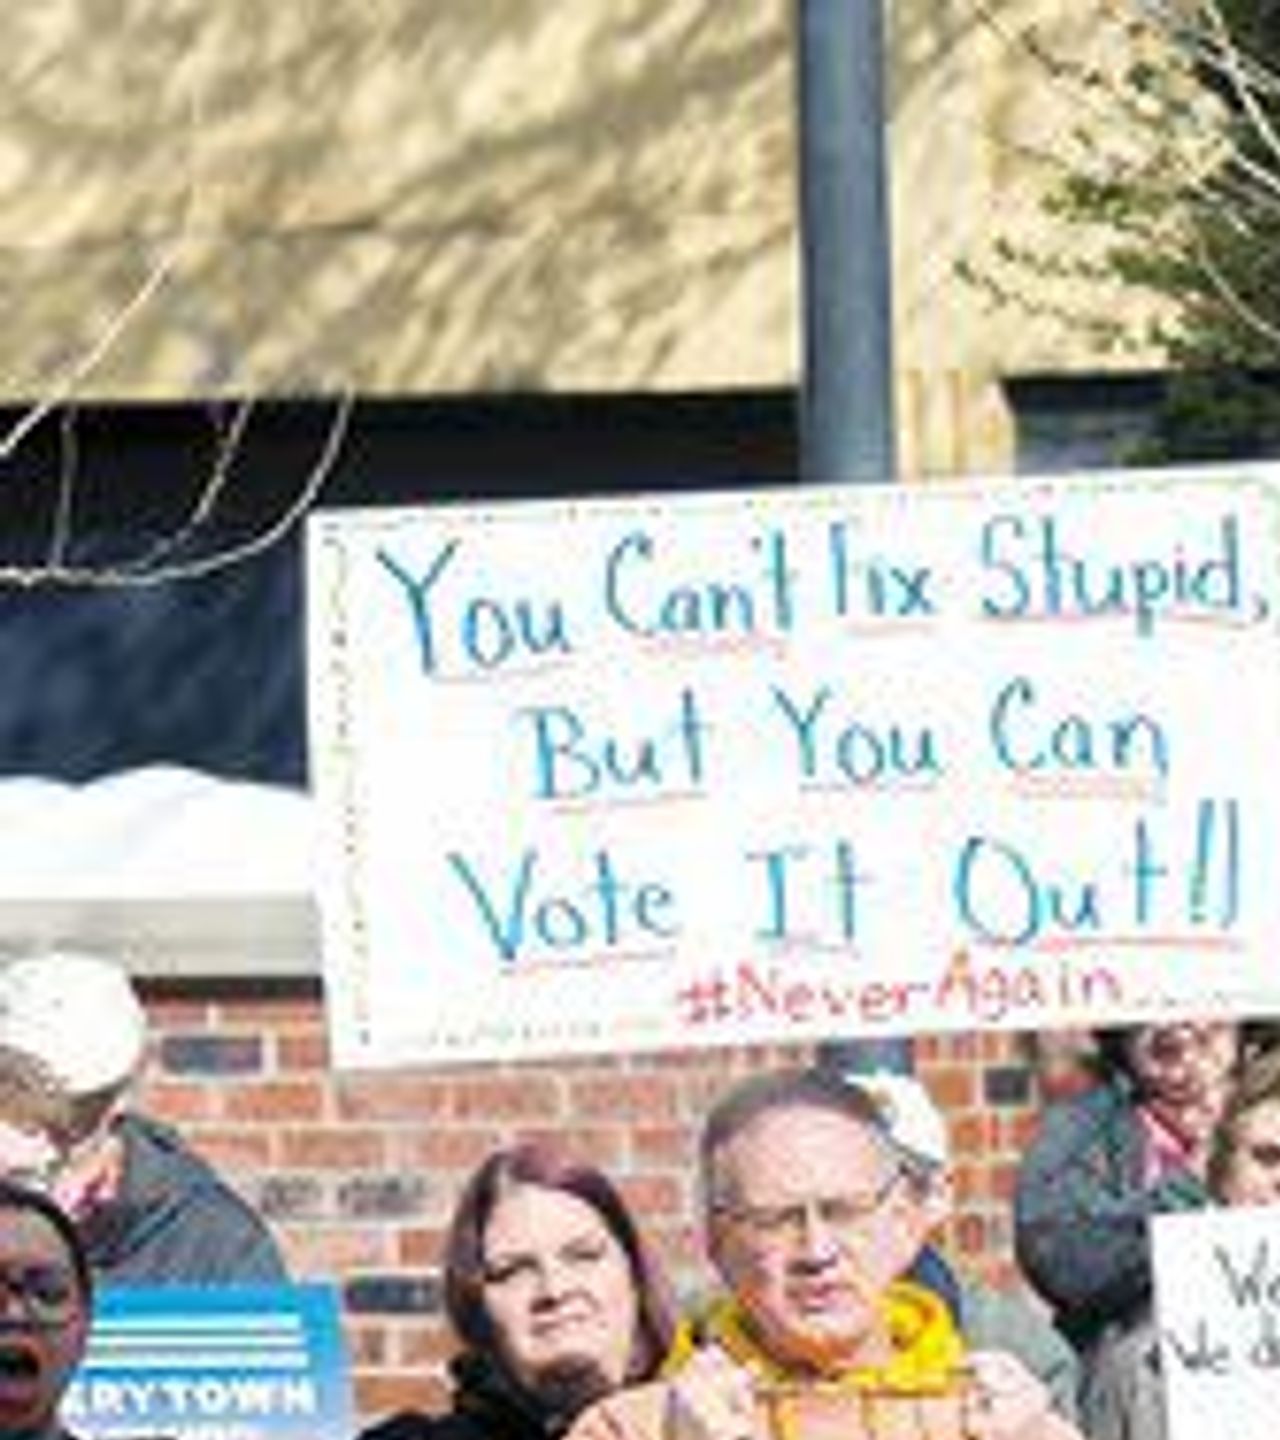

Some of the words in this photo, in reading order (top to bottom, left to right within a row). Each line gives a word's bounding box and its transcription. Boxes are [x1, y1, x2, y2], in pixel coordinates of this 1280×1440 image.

[376, 538, 571, 678] You
[604, 524, 792, 641] Can't
[979, 512, 1270, 637] Stupid,
[524, 688, 704, 799] But
[772, 684, 938, 785] You
[990, 676, 1169, 776] Can
[447, 848, 676, 961] Vote
[747, 840, 874, 939] It
[953, 799, 1240, 944] Out!!
[1168, 1322, 1231, 1375] We
